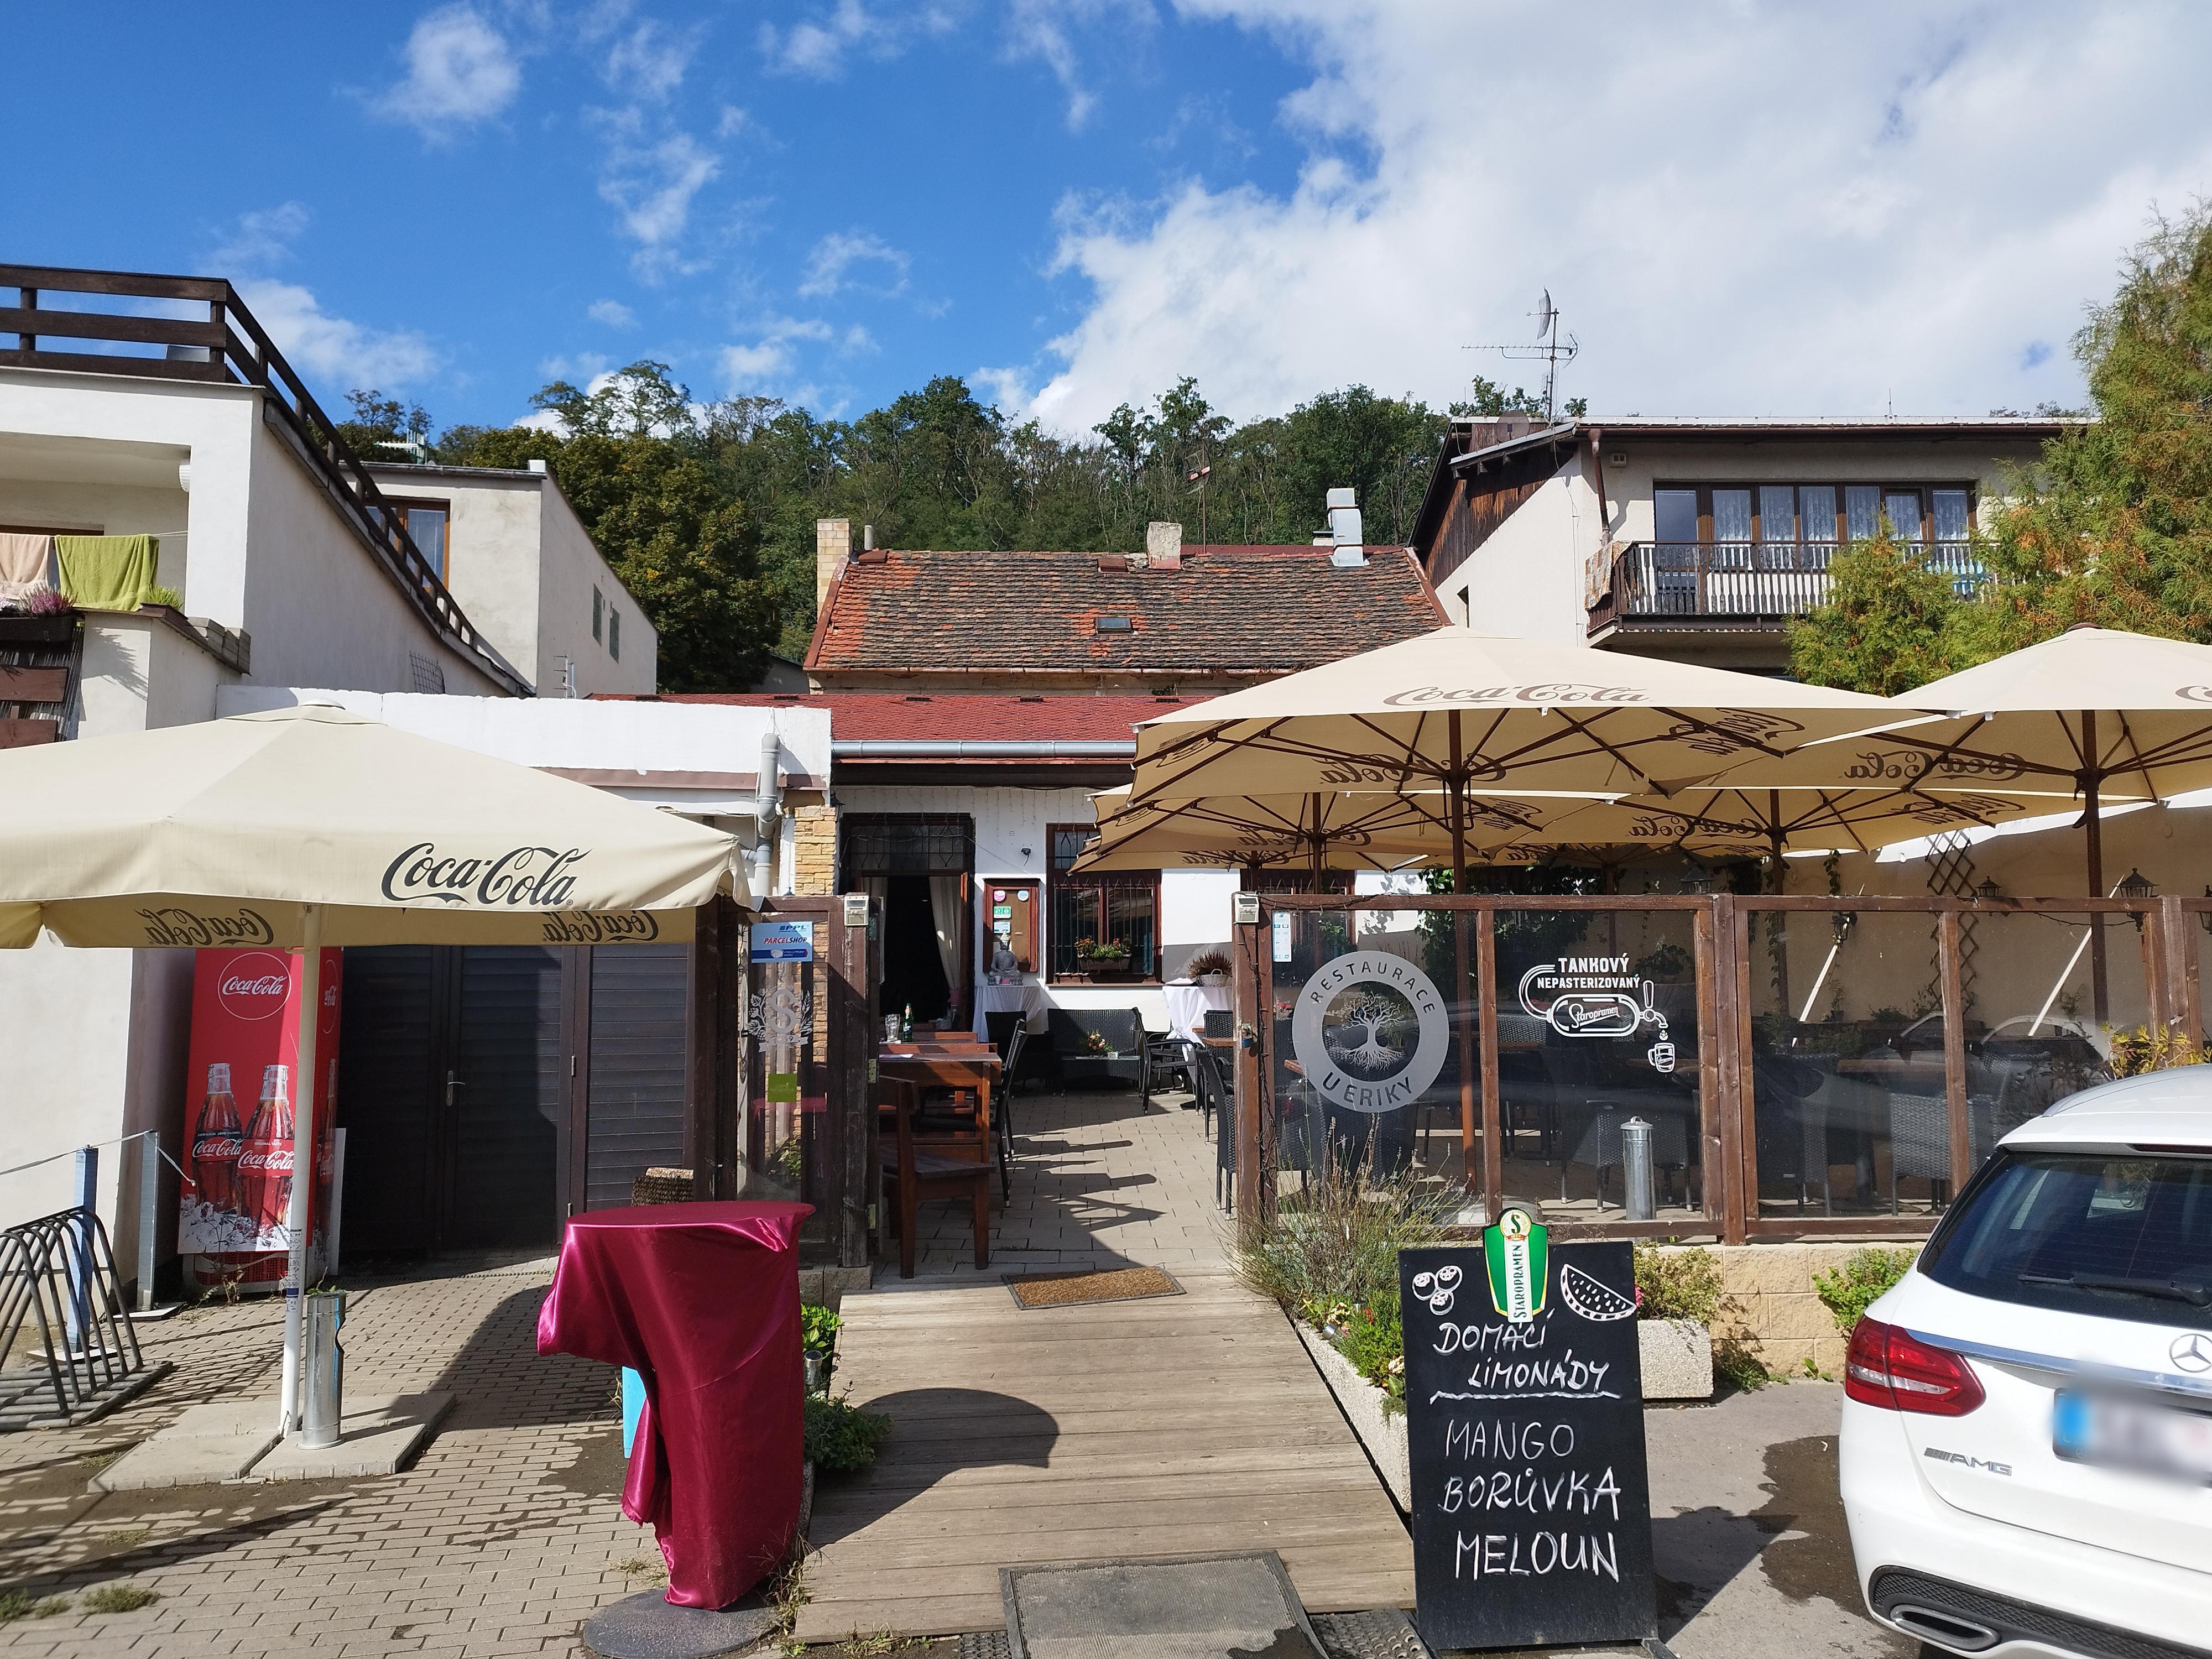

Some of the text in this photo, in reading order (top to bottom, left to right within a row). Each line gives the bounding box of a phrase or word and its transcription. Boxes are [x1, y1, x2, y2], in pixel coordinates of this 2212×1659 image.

[1383, 684, 1651, 706] Coca-Cola
[380, 842, 593, 906] Coca-Cola
[1558, 952, 1630, 973] TANKOVÝ
[222, 975, 288, 995] Coca-Cola
[1310, 961, 1436, 1014] RESTAURACE
[1537, 973, 1640, 989] NEPASTERIZOVANÝ
[1568, 1003, 1621, 1029] Staropramen
[1322, 1072, 1412, 1107] U ERIKY
[192, 1138, 244, 1158] Coca-Cola
[238, 1150, 295, 1170] Coca-Cola
[1513, 1245, 1527, 1318] STAROPRAMEN
[1432, 1308, 1556, 1355] DOMÁCÍ
[1446, 1418, 1574, 1460] MANGO
[1949, 1453, 2012, 1477] AMG
[1438, 1466, 1621, 1521] BORŮVKA
[1455, 1530, 1619, 1583] MELOUN
